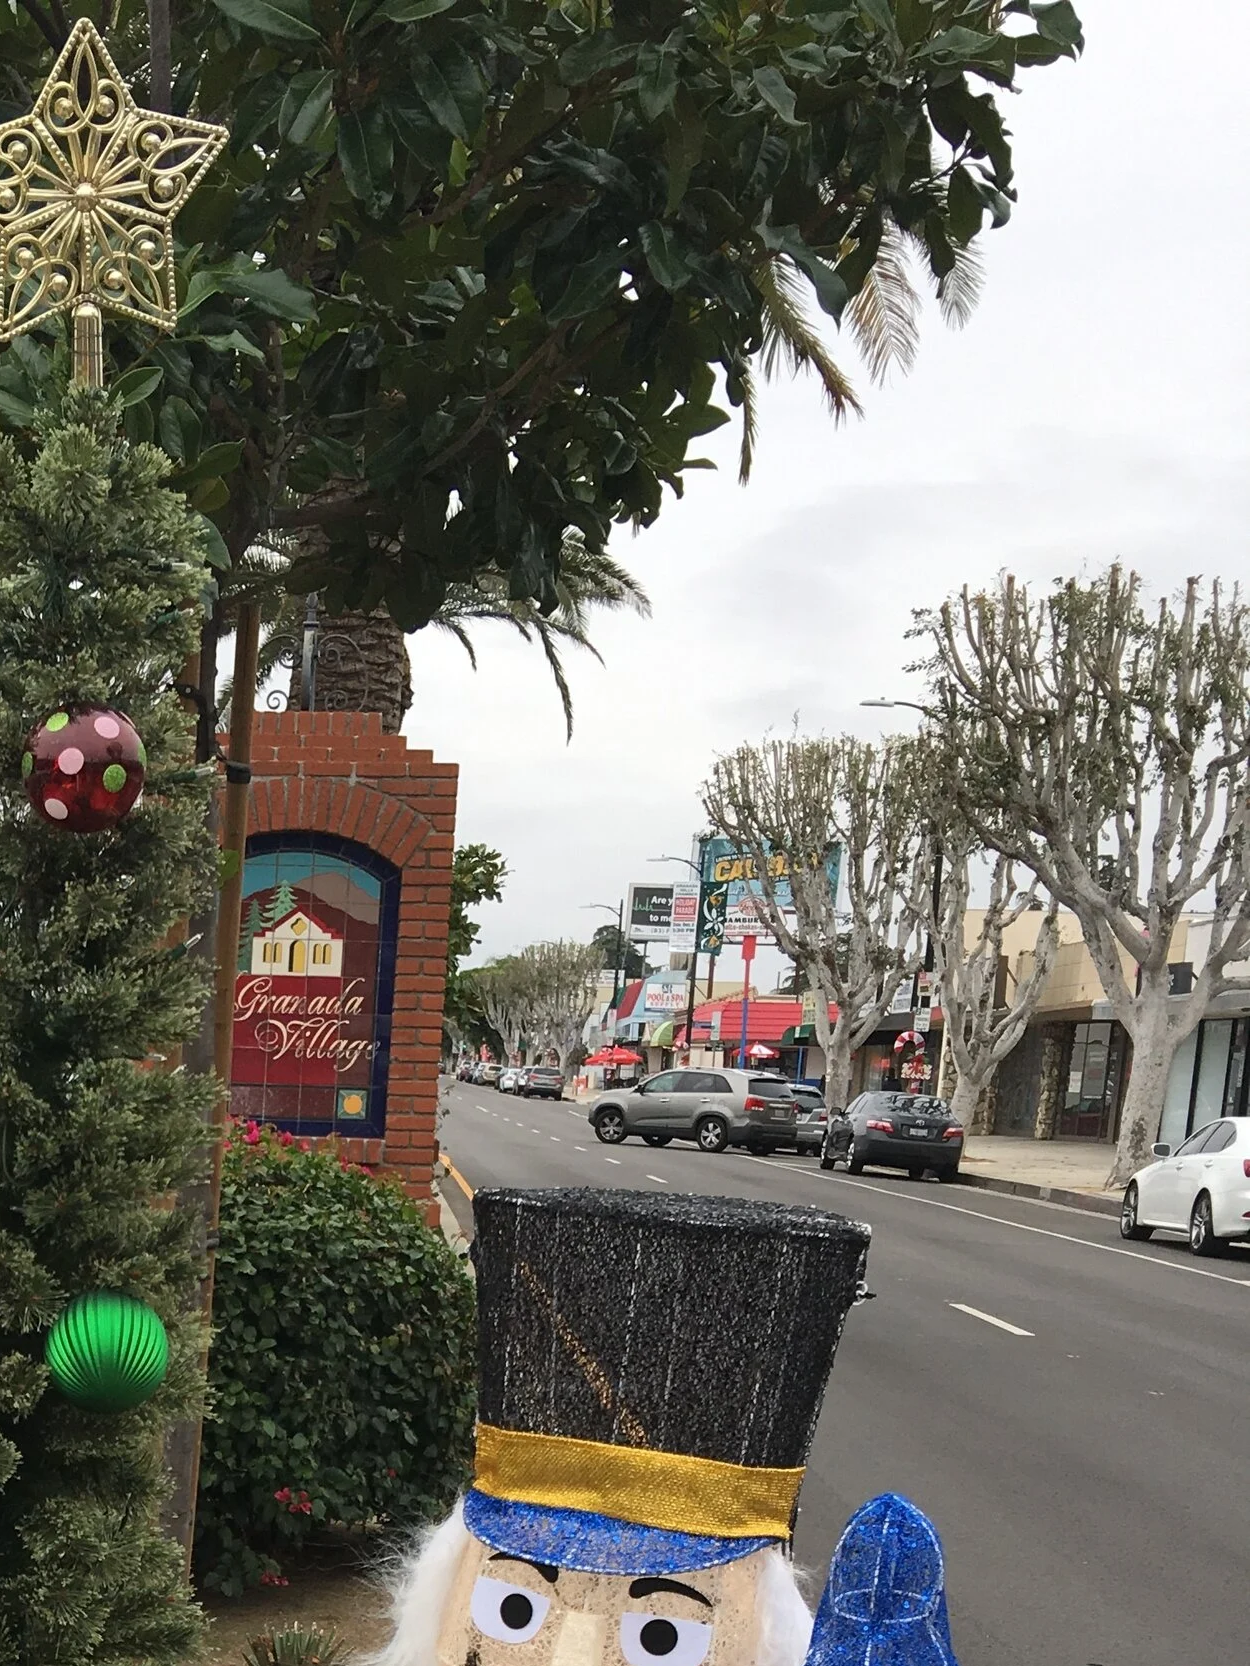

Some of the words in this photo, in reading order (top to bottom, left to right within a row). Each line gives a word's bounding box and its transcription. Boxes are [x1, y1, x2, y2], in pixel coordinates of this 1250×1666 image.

[651, 895, 667, 905] Are
[650, 913, 659, 922] to
[233, 974, 365, 1022] Granada
[647, 993, 664, 1001] POOL
[671, 994, 684, 1002] SPA
[255, 1017, 381, 1072] Village
